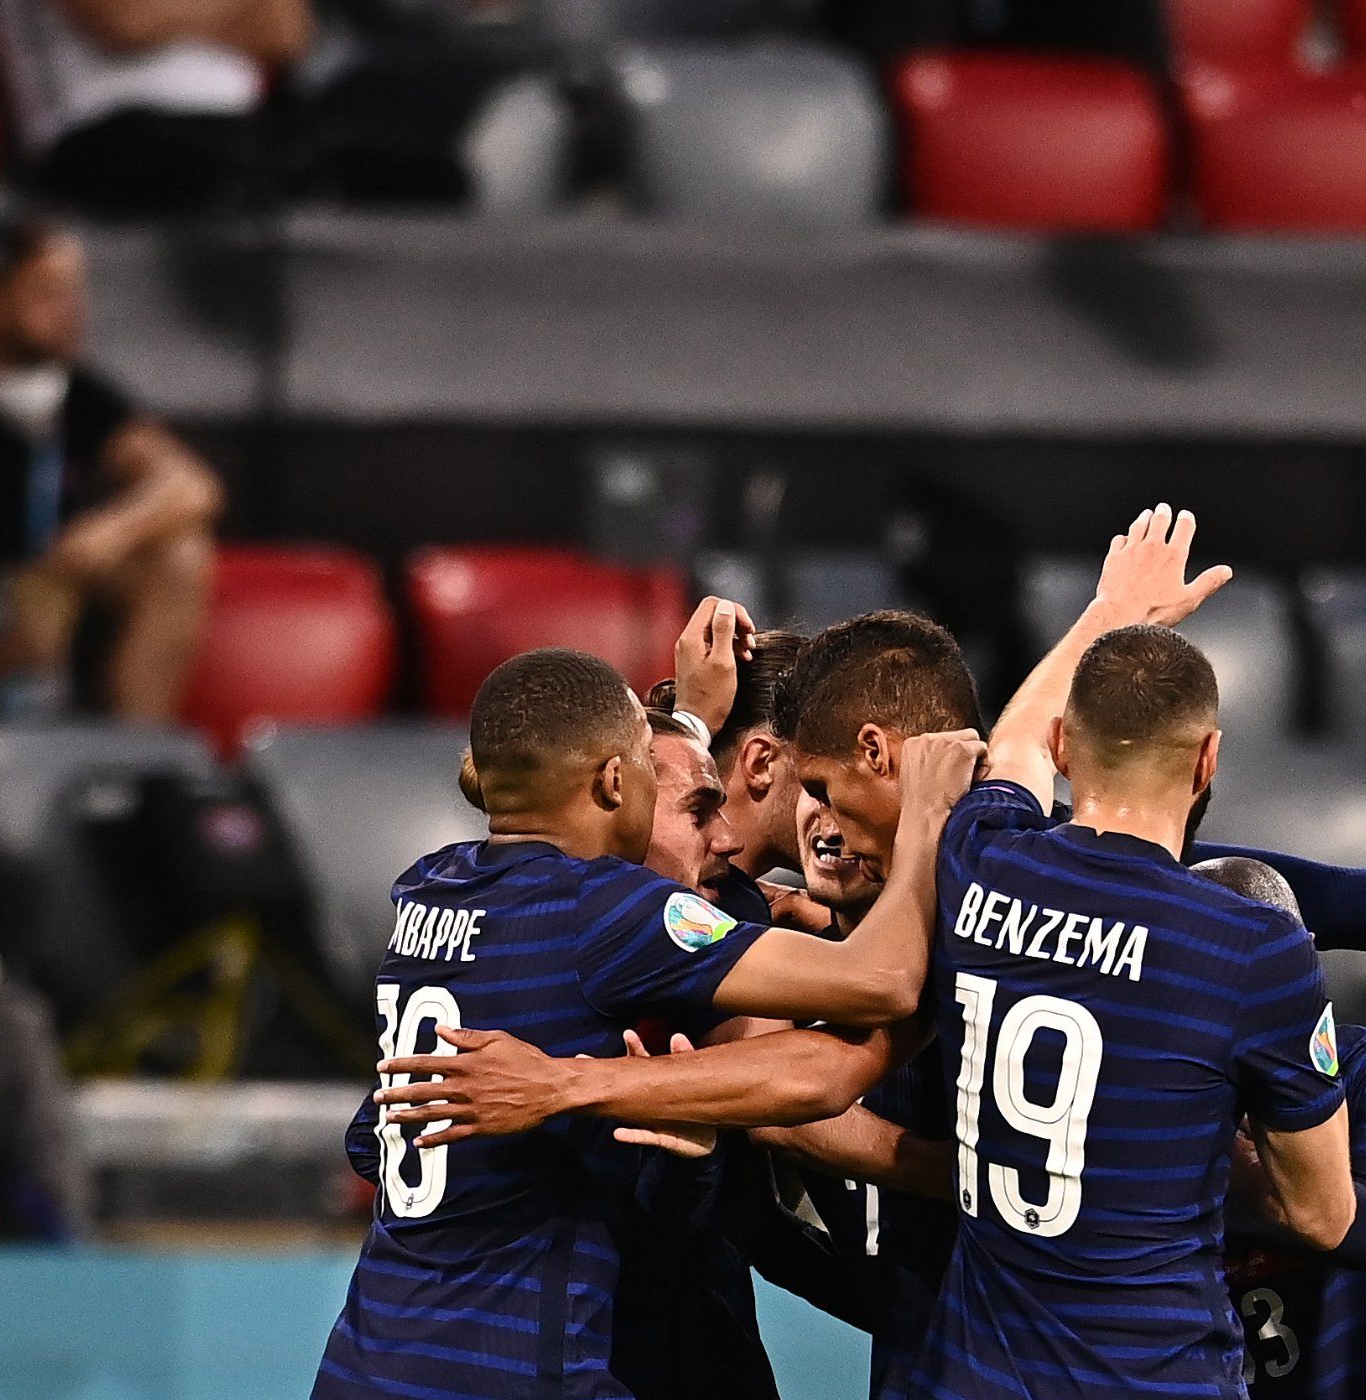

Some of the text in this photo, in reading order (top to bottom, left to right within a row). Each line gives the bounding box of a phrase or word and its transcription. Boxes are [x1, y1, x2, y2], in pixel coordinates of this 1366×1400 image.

[954, 882, 1149, 981] BENZEMA
[376, 984, 461, 1219] 10
[955, 972, 1103, 1237] 19
